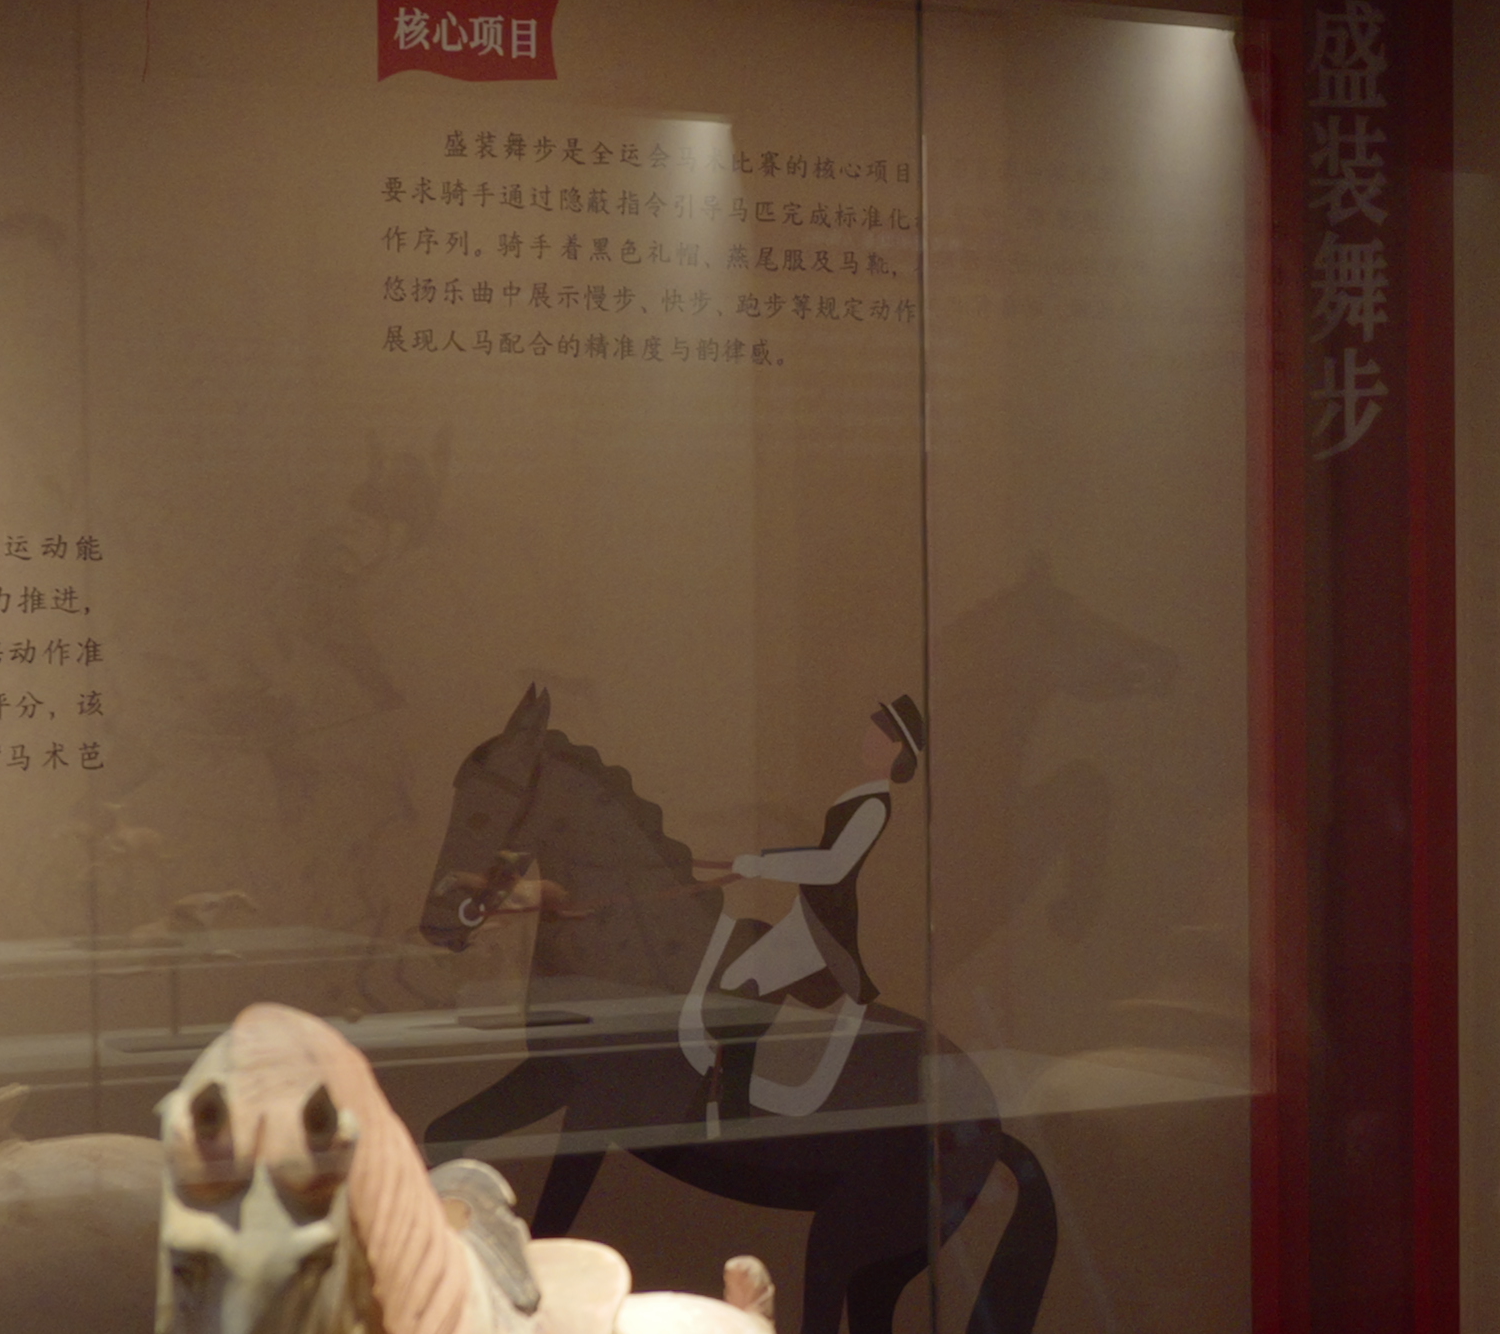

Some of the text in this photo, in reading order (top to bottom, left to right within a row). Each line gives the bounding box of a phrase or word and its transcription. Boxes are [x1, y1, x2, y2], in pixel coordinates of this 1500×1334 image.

[393, 6, 538, 60] 核心项目
[381, 175, 922, 232] 要求骑手通过隐蔽指令引导马匹完成标准化
[381, 226, 922, 277] 作序列。骑手着黑色礼帽、燕尾服及马靴，
